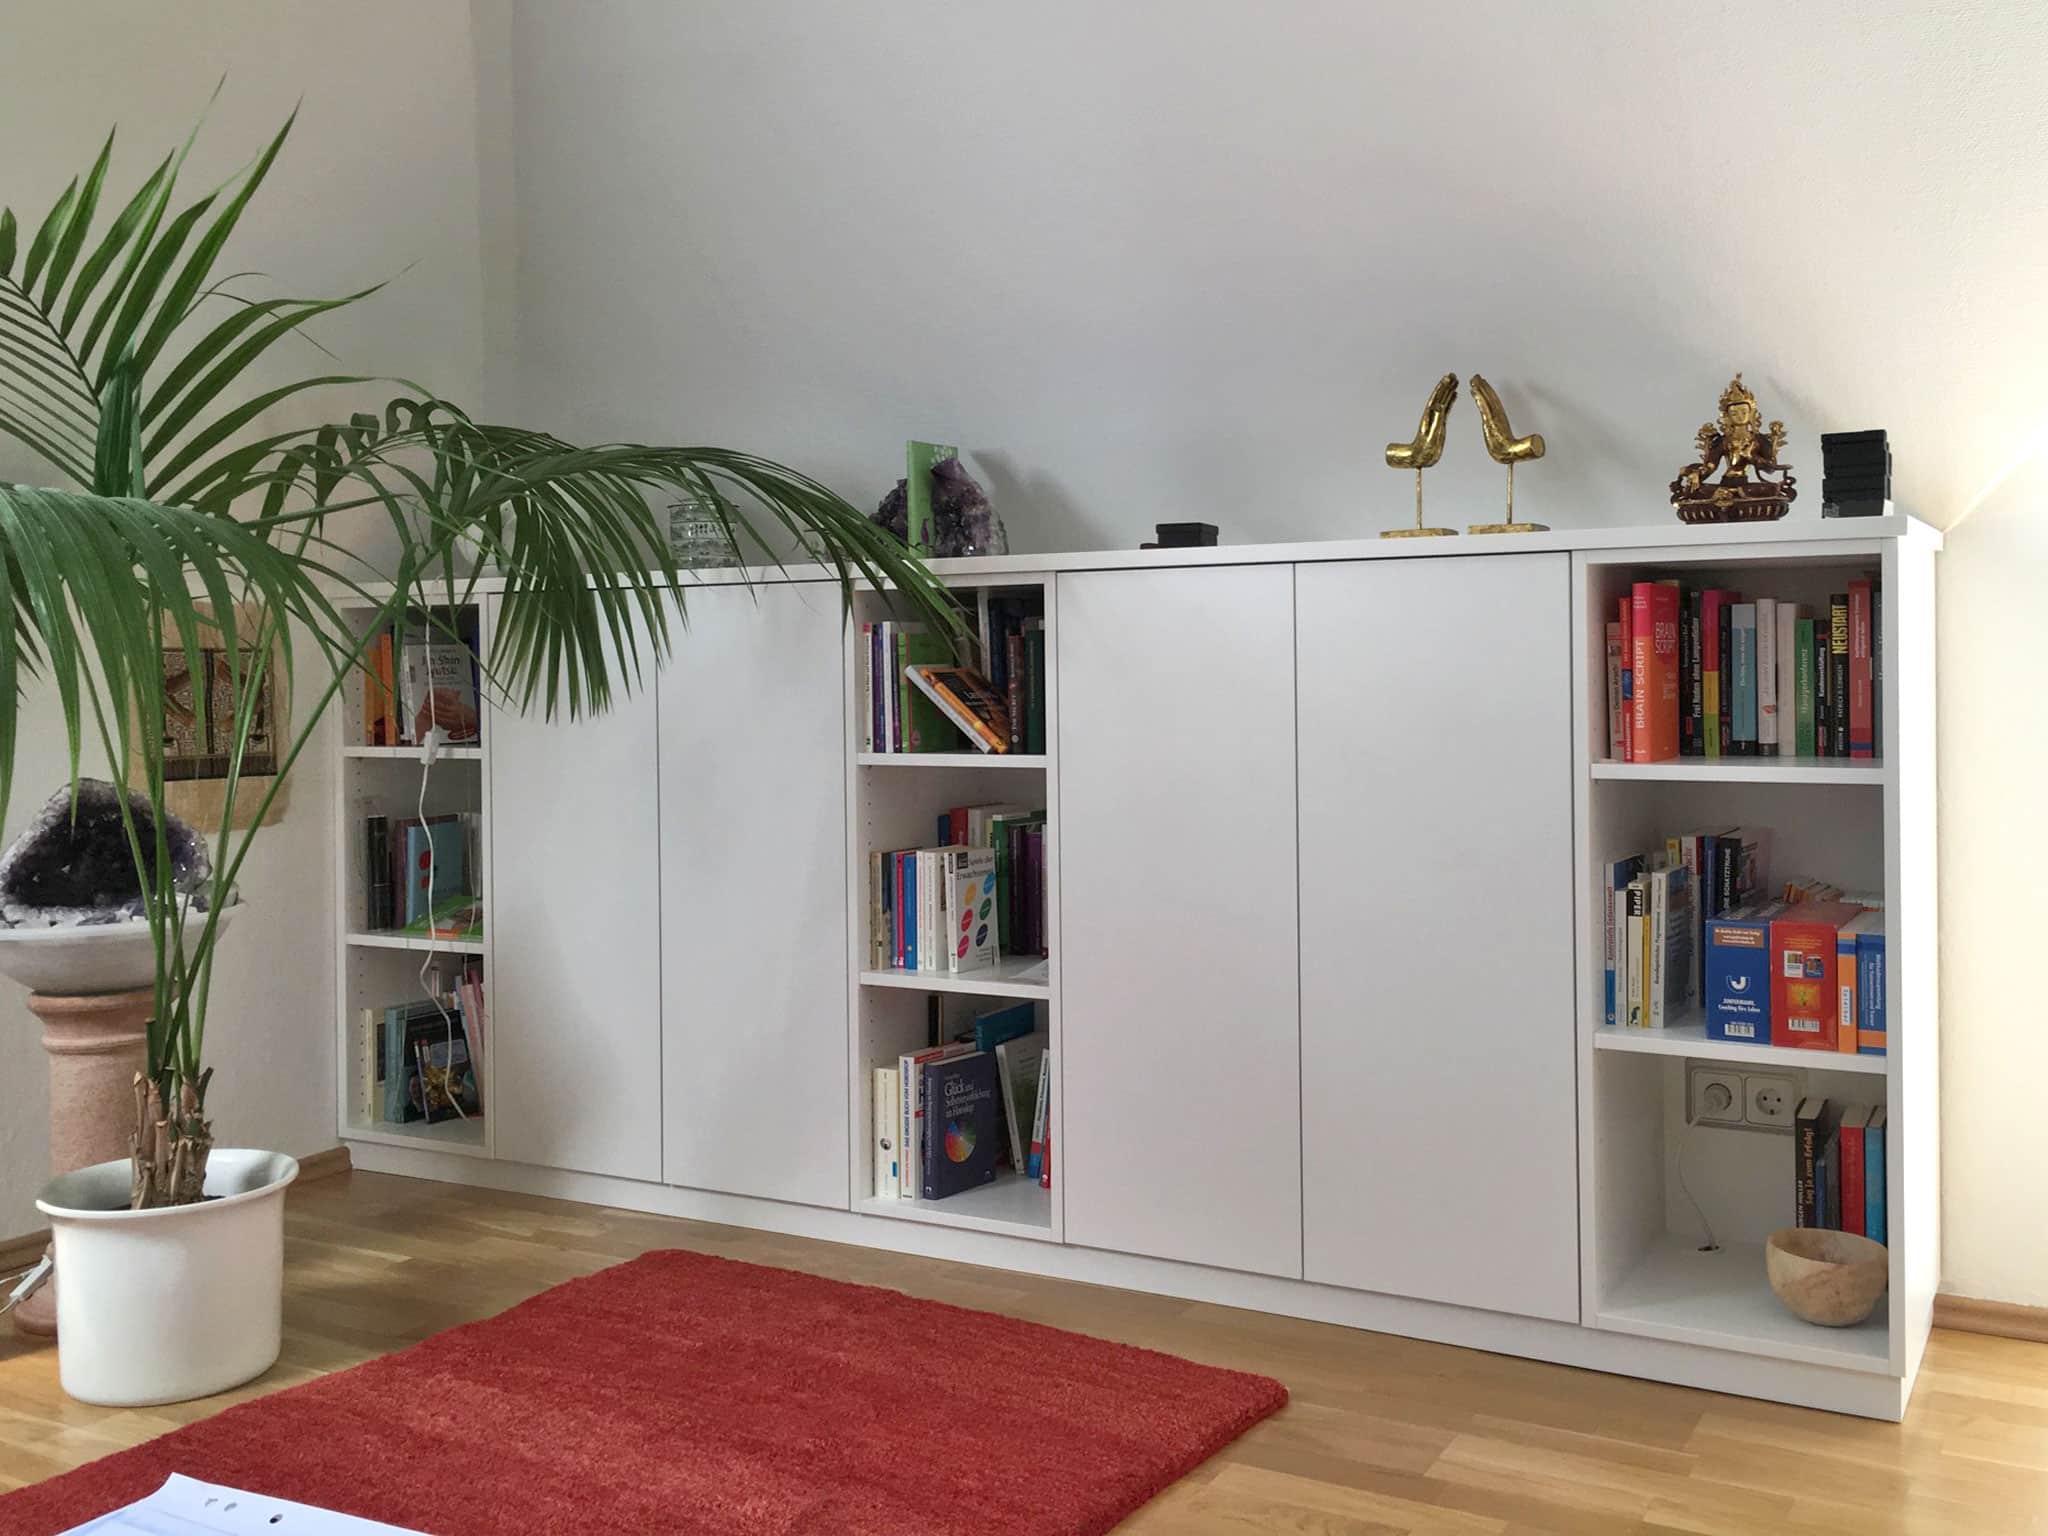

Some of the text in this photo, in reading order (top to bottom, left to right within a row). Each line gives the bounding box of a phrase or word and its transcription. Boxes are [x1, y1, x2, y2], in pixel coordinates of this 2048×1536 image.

[1831, 604, 1849, 655] NEUSTART
[1635, 639, 1645, 729] BRAIN SCRIPT
[1633, 890, 1642, 916] PIPER
[1803, 1128, 1815, 1158] Erfolg!
[1805, 1159, 1813, 1178] zum
[1805, 1189, 1815, 1205] Sag
